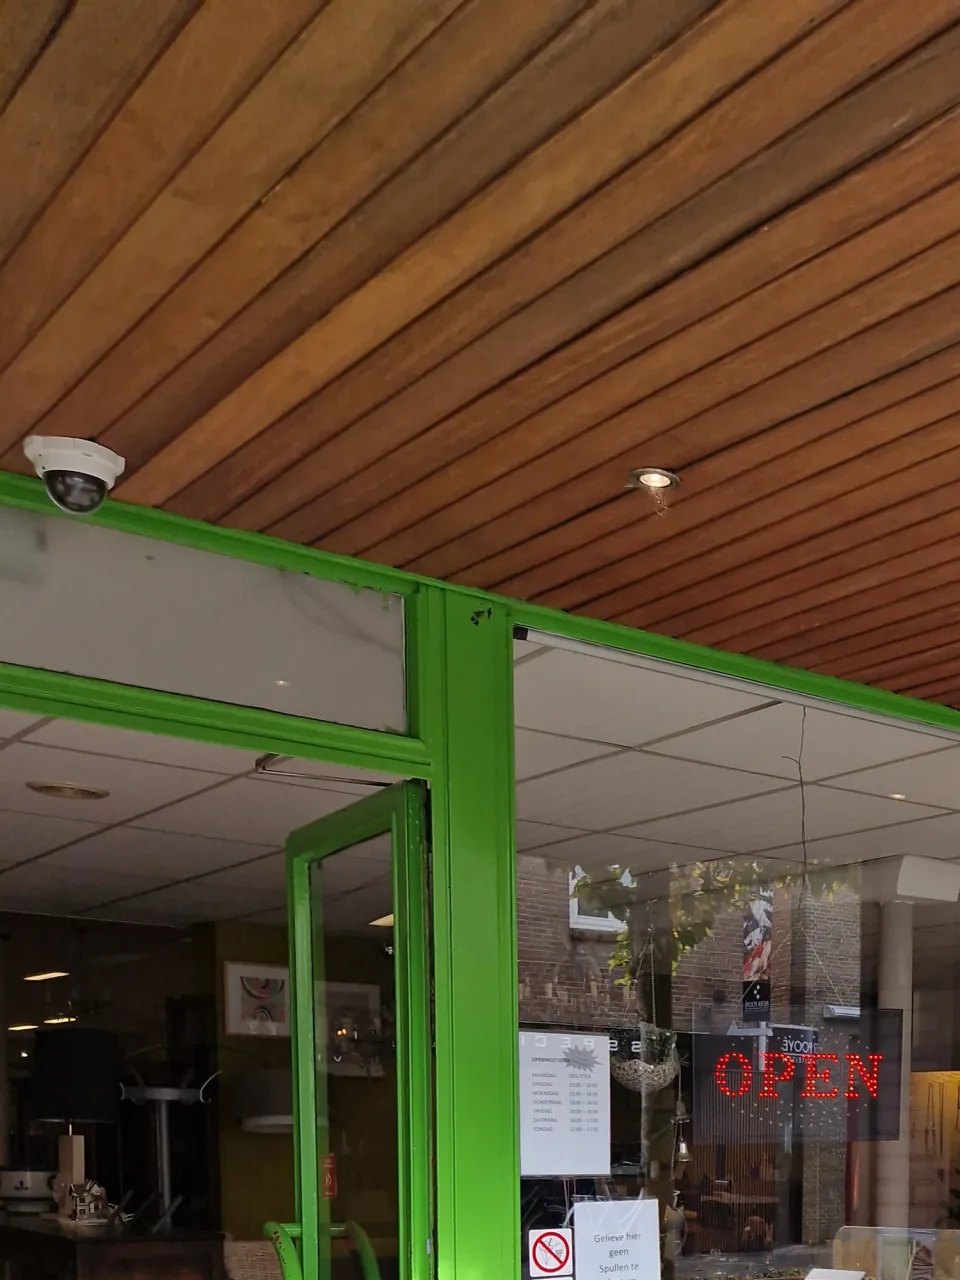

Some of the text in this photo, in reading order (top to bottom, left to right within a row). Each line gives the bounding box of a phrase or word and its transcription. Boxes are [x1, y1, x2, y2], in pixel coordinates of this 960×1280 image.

[714, 1053, 883, 1098] OPEN
[593, 1232, 642, 1243] Gelieve hier
[608, 1248, 629, 1258] geen
[599, 1263, 639, 1275] Spullen te
